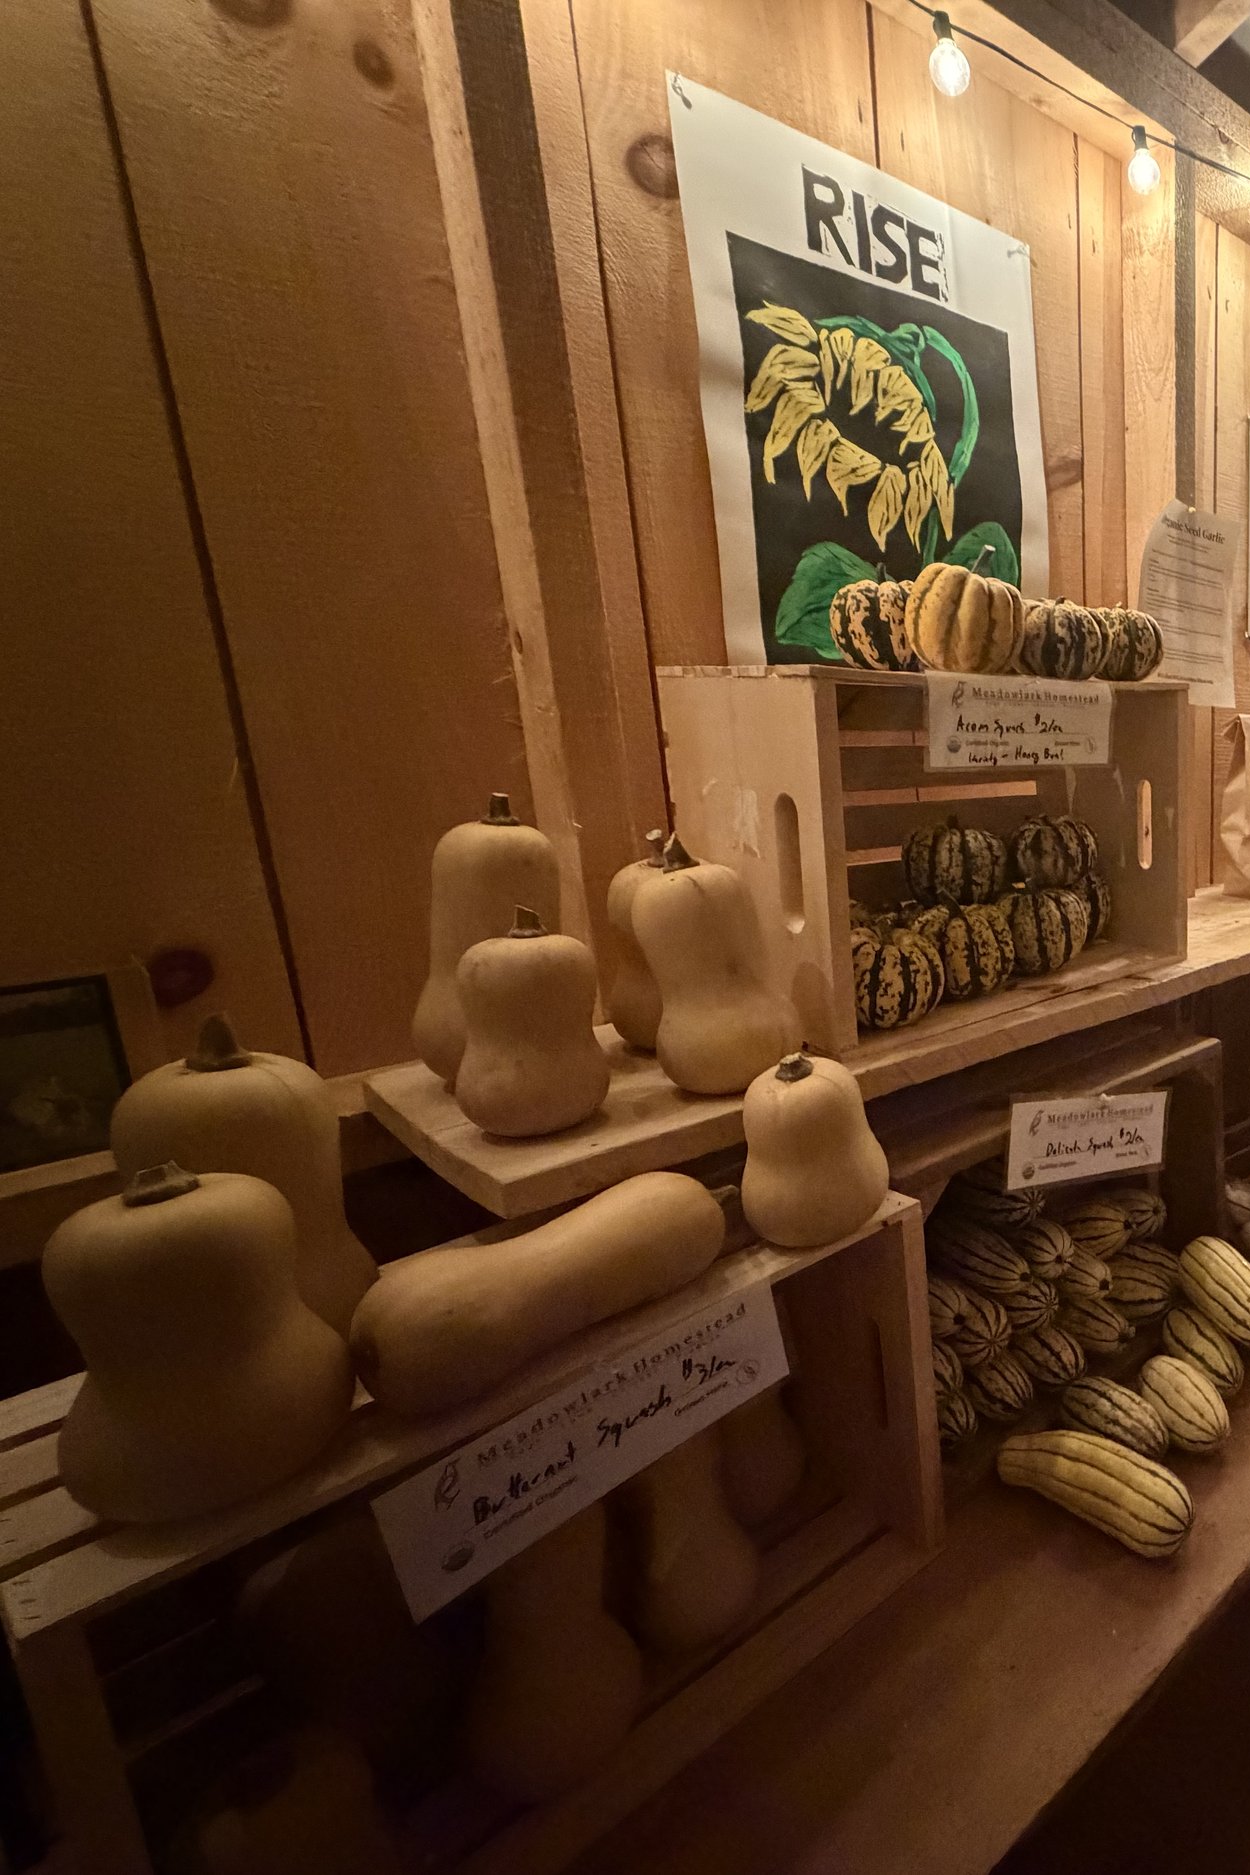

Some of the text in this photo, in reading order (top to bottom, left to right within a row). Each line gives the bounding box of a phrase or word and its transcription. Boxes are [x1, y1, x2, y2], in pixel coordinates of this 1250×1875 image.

[801, 163, 949, 303] RISE
[972, 686, 1041, 700] Meadowlark
[1043, 691, 1099, 705] Homestead
[477, 1372, 627, 1466] Meadowlark
[632, 1302, 746, 1374] Homestead
[596, 1384, 672, 1448] Squash
